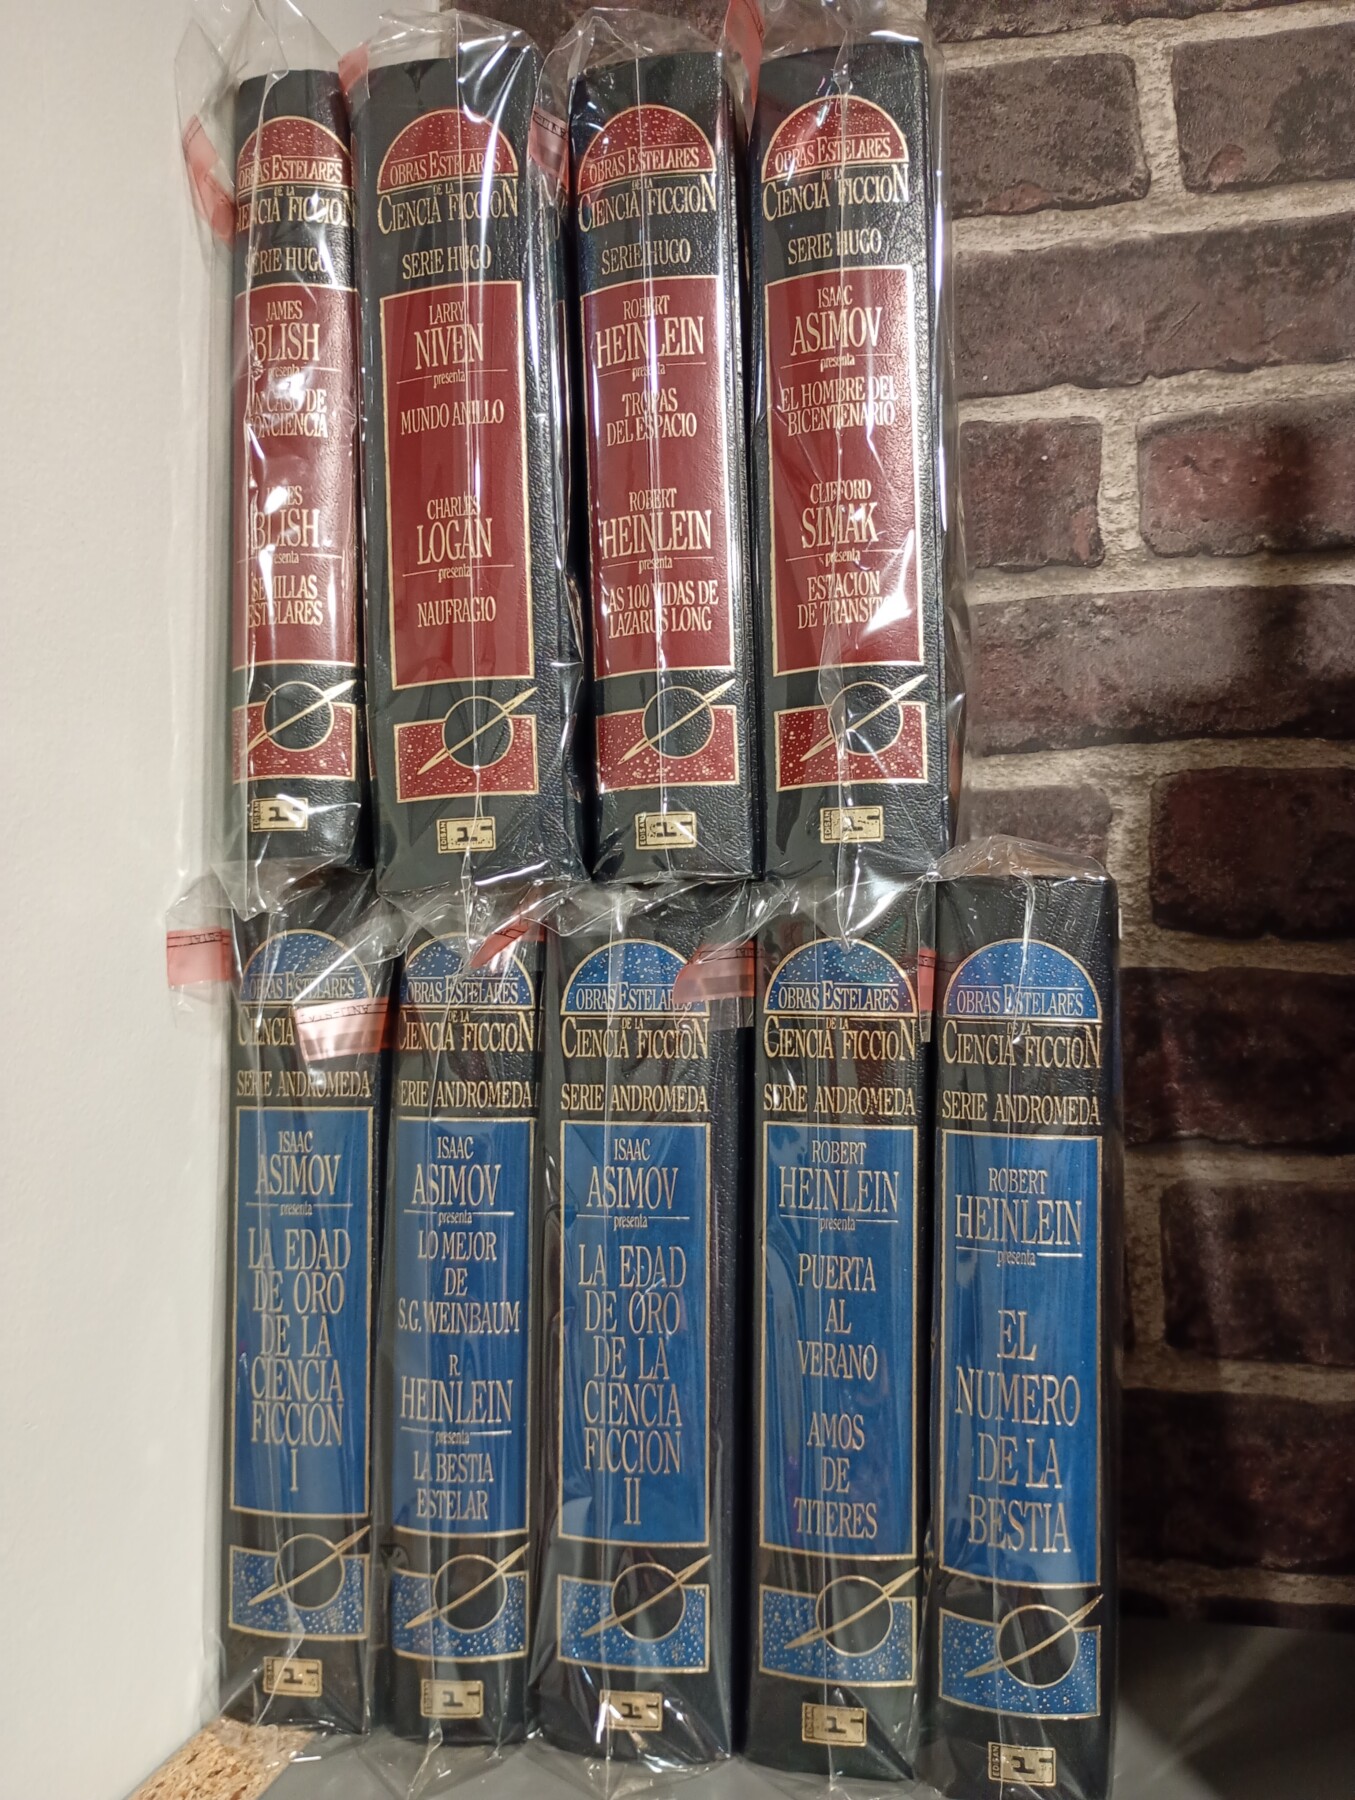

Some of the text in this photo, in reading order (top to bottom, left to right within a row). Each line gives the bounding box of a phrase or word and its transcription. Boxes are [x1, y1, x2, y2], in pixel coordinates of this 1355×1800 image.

[272, 154, 343, 183] ESTELARES
[589, 146, 700, 184] OBRAS ESTELARES
[775, 136, 891, 173] OBRAS ESTELARES
[390, 159, 427, 186] OBRAS
[433, 183, 454, 195] DE LA
[632, 178, 653, 191] DE LA
[822, 169, 831, 180] DE
[274, 186, 295, 196] DE LA
[578, 174, 717, 232] CIENCIA FICCION
[763, 164, 909, 221] CIENCIA FICCION
[378, 195, 442, 234] CIENCIA
[402, 244, 491, 279] SERIE HUGO
[601, 238, 691, 275] SERIE HUGO
[788, 227, 882, 265] SERIE HUGO
[266, 300, 303, 322] JAMES
[429, 301, 466, 325] LARRY
[817, 285, 853, 308] ISAAC
[253, 322, 320, 362] BLISH
[413, 323, 484, 370] NIVEN
[790, 306, 883, 356] ASIMOV
[433, 369, 466, 389] presenta
[820, 353, 855, 372] presenta
[306, 389, 327, 413] DE
[781, 387, 799, 413] EL
[801, 376, 865, 408] HOMBRE
[401, 399, 504, 435] MUNDO ANILLO
[607, 412, 698, 446] DEL ESPACIO
[788, 400, 896, 437] BICENTENARIO
[427, 495, 480, 520] CHARLES
[629, 488, 677, 512] ROBERT
[810, 478, 872, 504] CLIFFORD
[251, 508, 320, 550] BLISH
[417, 518, 492, 565] LOGAN
[601, 509, 712, 560] HEINLEIN
[802, 502, 879, 549] SIMAK
[438, 563, 472, 583] presenta
[638, 555, 673, 574] presenta
[825, 548, 860, 568] presenta
[627, 583, 650, 609] 100
[698, 580, 719, 605] DE
[807, 570, 880, 601] ESTACION
[417, 596, 496, 628] NAUFRAGIO
[671, 606, 712, 632] LONG
[797, 602, 818, 629] DE
[407, 975, 519, 1004] OBRAS ESTELARES
[575, 987, 616, 1010] OBRAS
[778, 980, 899, 1012] OBRAS ESTELARES
[956, 983, 1084, 1016] OBRAS ESTELARES
[460, 1010, 469, 1022] LA
[461, 1011, 535, 1052] FICCION
[621, 1018, 644, 1029] DE LA
[825, 1018, 849, 1030] DE LA
[561, 1016, 710, 1059] CIENCIA FICCION
[764, 1015, 917, 1061] CIENCIA FICCION
[943, 1020, 1102, 1069] CIENCIA FICCION
[236, 1070, 372, 1098] SERIE ANDROMEDA
[434, 1080, 533, 1108] ANDROMEDA
[560, 1083, 711, 1113] SERIE ANDROMEDA
[763, 1083, 916, 1116] SERIE ANDROMEDA
[942, 1090, 1102, 1125] SERIE ANDROMEDA
[278, 1130, 314, 1153] ISAAC
[437, 1136, 474, 1159] ISAAC
[613, 1138, 650, 1161] ISAAC
[812, 1140, 867, 1165] ROBERT
[255, 1154, 341, 1196] ASIMOV
[411, 1163, 501, 1207] ASIMOV
[586, 1165, 678, 1210] ASIMOV
[779, 1166, 899, 1213] HEINLEIN
[988, 1167, 1048, 1195] ROBERT
[280, 1201, 313, 1216] presenta
[438, 1209, 472, 1227] presenta
[613, 1213, 648, 1231] presenta
[819, 1216, 855, 1232] presenta
[955, 1194, 1082, 1245] HEINLEIN
[248, 1227, 351, 1271] LA EDAD
[418, 1230, 497, 1261] LO MEJOR
[996, 1249, 1036, 1267] presenta
[444, 1267, 468, 1296] DE
[578, 1244, 687, 1288] LA EDAD
[798, 1253, 877, 1292] PUERTA
[253, 1271, 345, 1314] DE ORO
[423, 1301, 520, 1334] WEINBAUM
[585, 1290, 681, 1335] DE ORO
[825, 1298, 852, 1334] AL
[260, 1314, 332, 1357] DE LA
[997, 1309, 1038, 1360] EL
[449, 1354, 460, 1376] R
[593, 1335, 670, 1380] DE LA
[797, 1340, 878, 1381] VERANO
[251, 1356, 344, 1402] CIENCIA
[955, 1366, 1081, 1426] NUMERO
[400, 1375, 513, 1424] HEINLEIN
[583, 1379, 683, 1427] CIENCIA
[252, 1400, 343, 1446] FICCION
[434, 1429, 470, 1446] presenta
[806, 1411, 865, 1450] AMOS
[413, 1450, 494, 1483] LA BESTIA
[583, 1427, 681, 1475] FICCION
[977, 1432, 1062, 1488] DE LA
[290, 1448, 299, 1492] I
[821, 1456, 850, 1493] DE
[416, 1488, 488, 1520] ESTELAR
[624, 1477, 641, 1525] II
[793, 1497, 878, 1539] TITERES
[968, 1494, 1071, 1553] BESTIA
